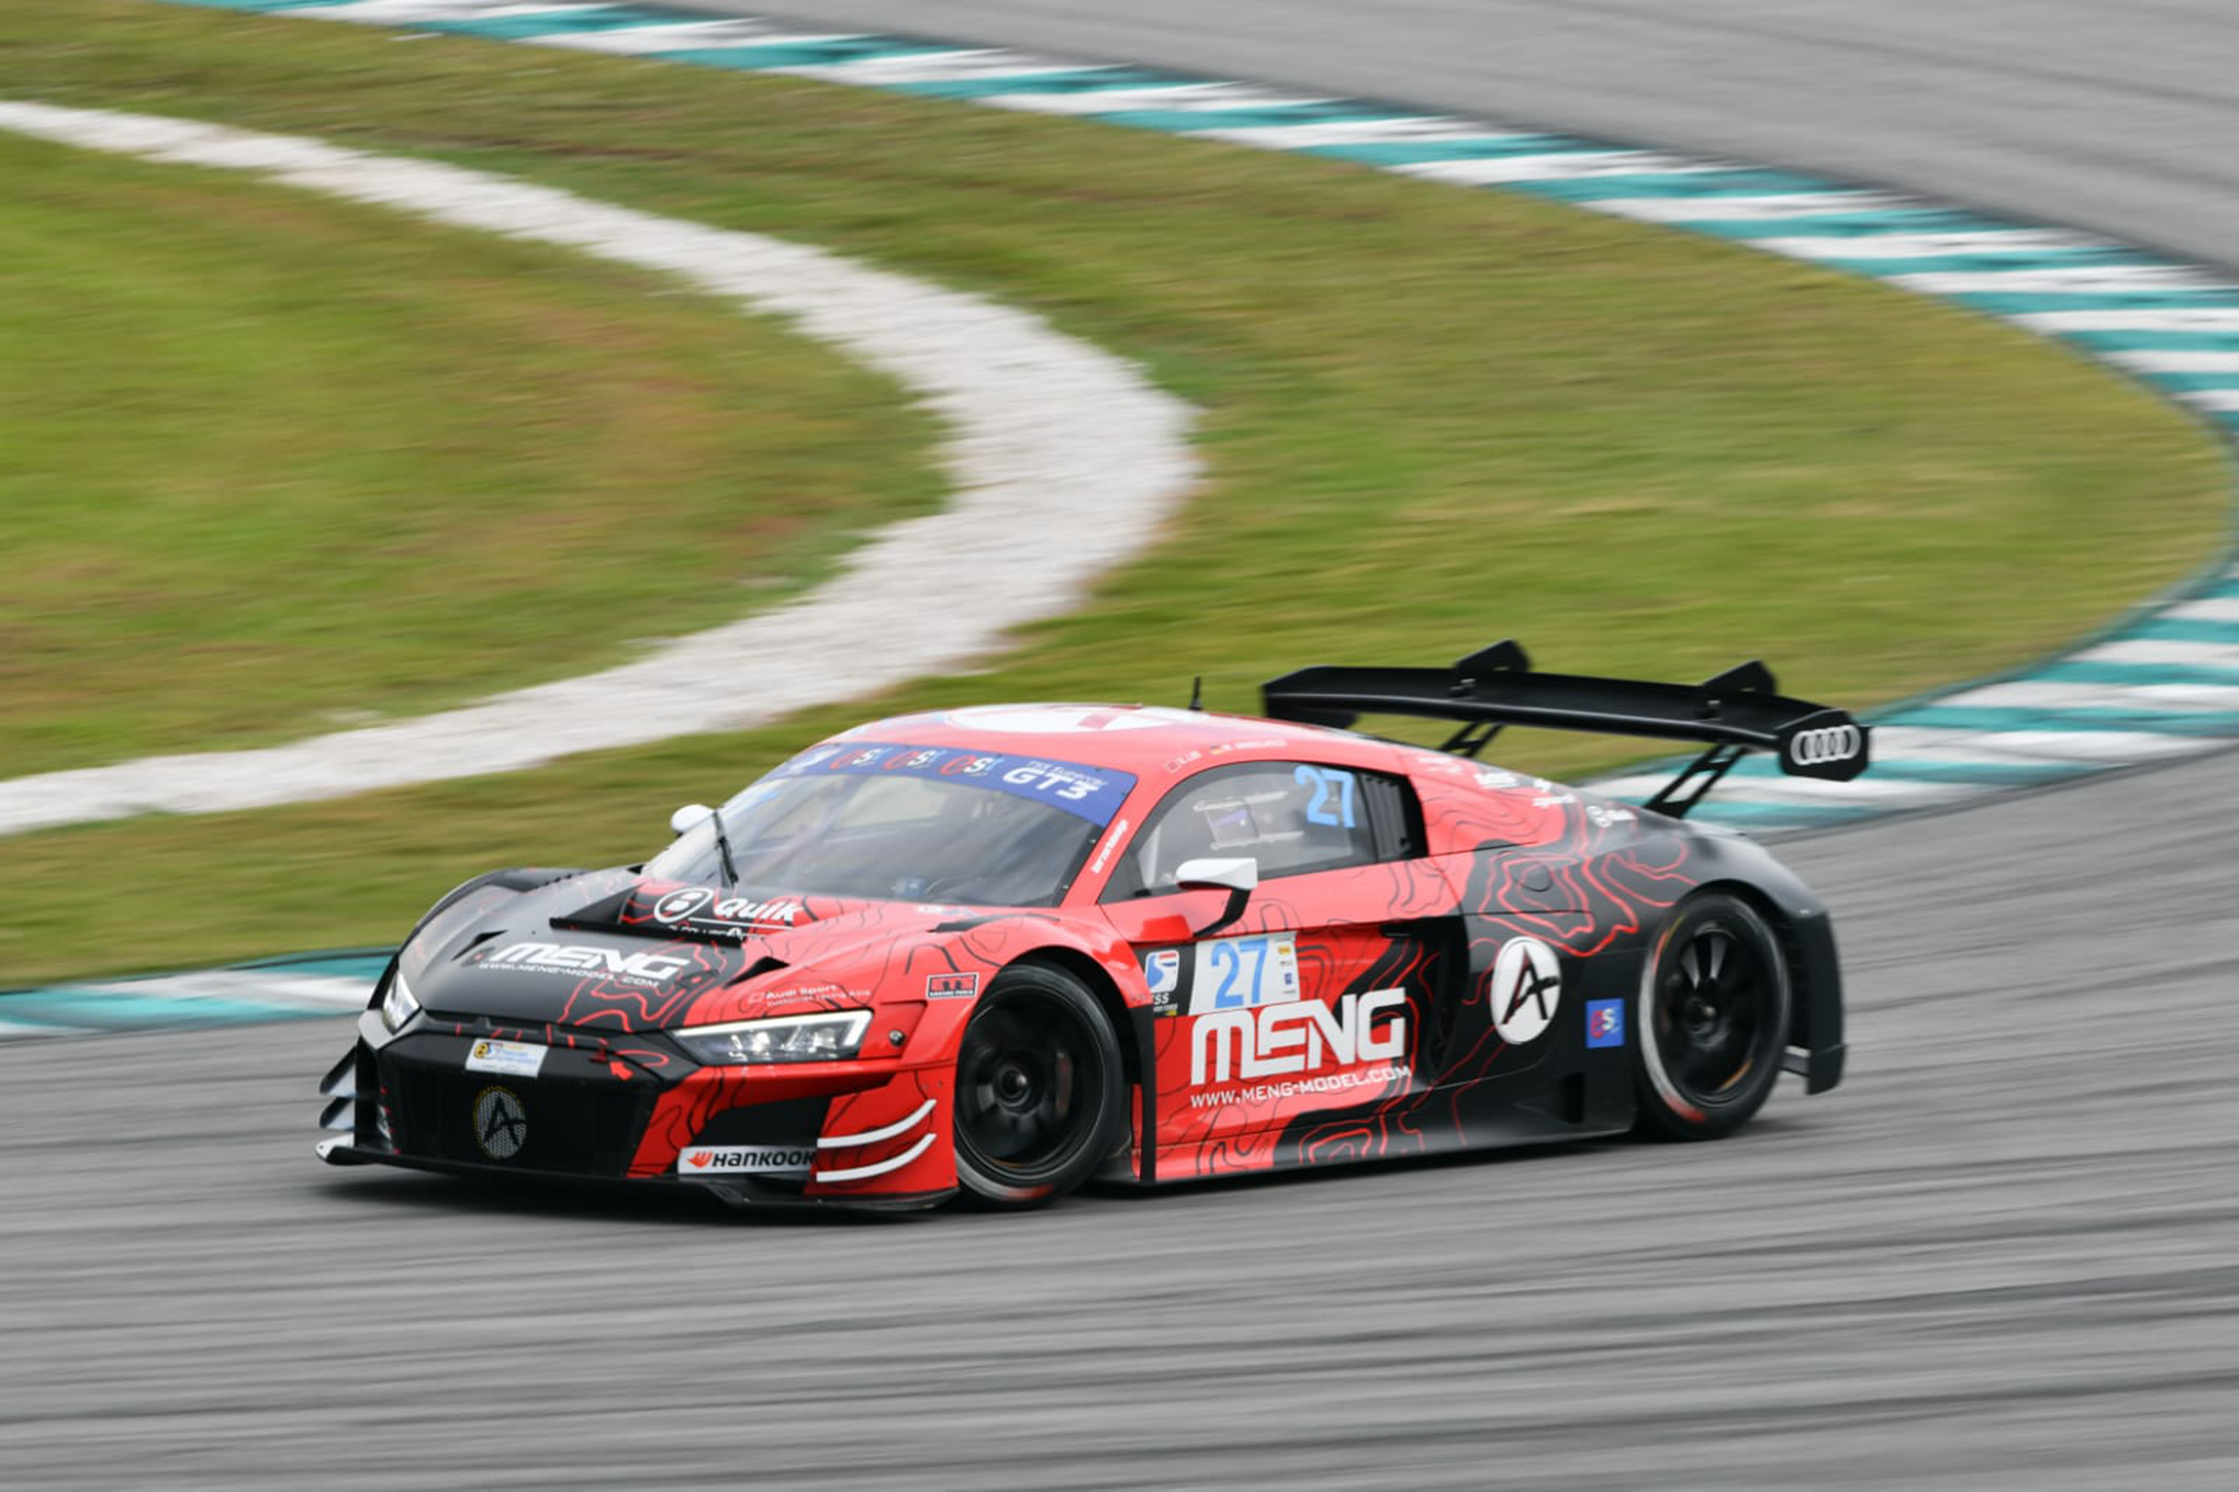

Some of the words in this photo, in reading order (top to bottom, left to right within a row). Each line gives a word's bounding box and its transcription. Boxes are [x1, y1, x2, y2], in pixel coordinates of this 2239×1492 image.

[1002, 767, 1099, 800] GT3
[1294, 765, 1356, 829] 27
[714, 898, 801, 922] Quik
[490, 942, 691, 980] MENG
[1211, 938, 1269, 1009] 27
[766, 989, 797, 1000] Audi
[800, 984, 838, 998] Sport
[1191, 987, 1406, 1086] MENG
[1190, 1065, 1412, 1109] WWW.MENG-MODEL.COM
